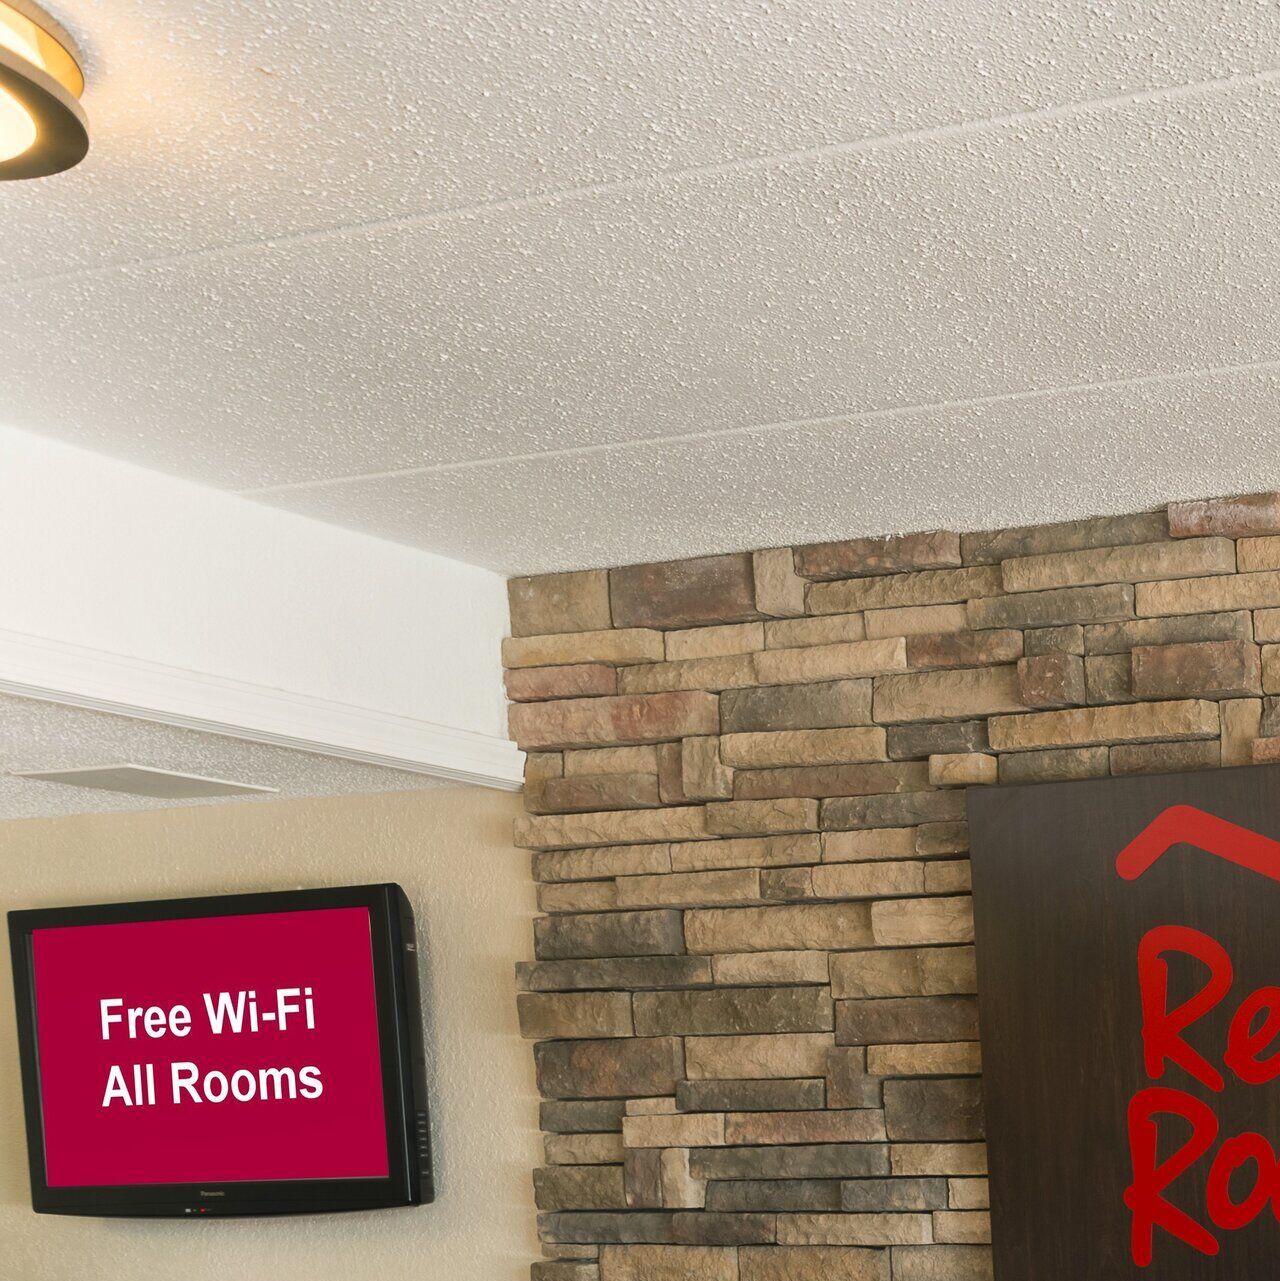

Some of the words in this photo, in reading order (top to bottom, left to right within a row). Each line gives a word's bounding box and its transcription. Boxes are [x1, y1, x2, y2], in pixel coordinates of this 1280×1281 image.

[99, 998, 192, 1040] Free
[203, 987, 316, 1035] Wi-Fi
[102, 1064, 156, 1107] All
[171, 1061, 323, 1104] Rooms
